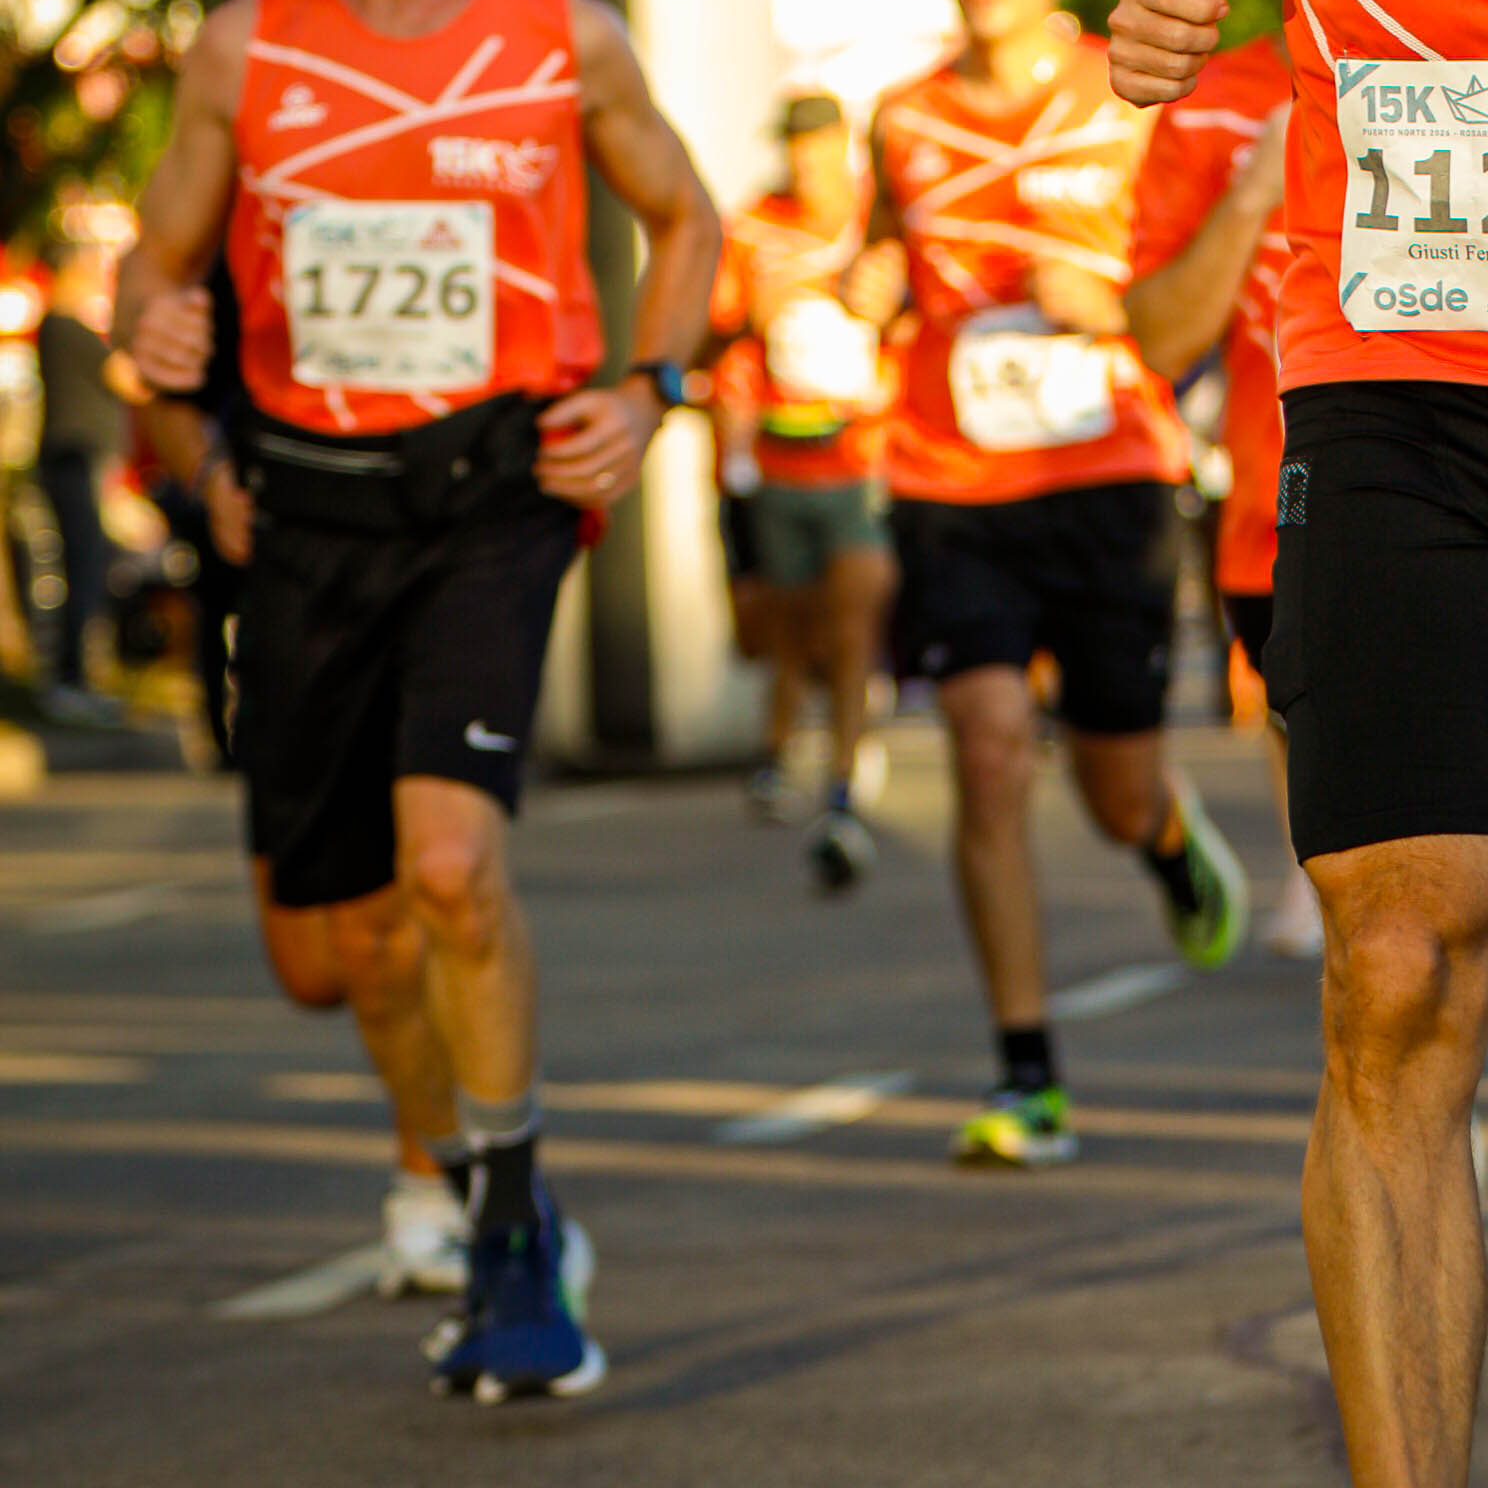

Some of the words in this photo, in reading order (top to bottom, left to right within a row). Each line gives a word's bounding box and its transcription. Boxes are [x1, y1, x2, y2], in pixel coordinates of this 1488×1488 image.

[1361, 85, 1437, 123] 15K
[1361, 128, 1395, 137] PUERTO
[1397, 128, 1427, 137] NORTE
[1408, 243, 1460, 260] Giusti
[300, 263, 478, 320] 1726
[1374, 279, 1469, 314] osde
